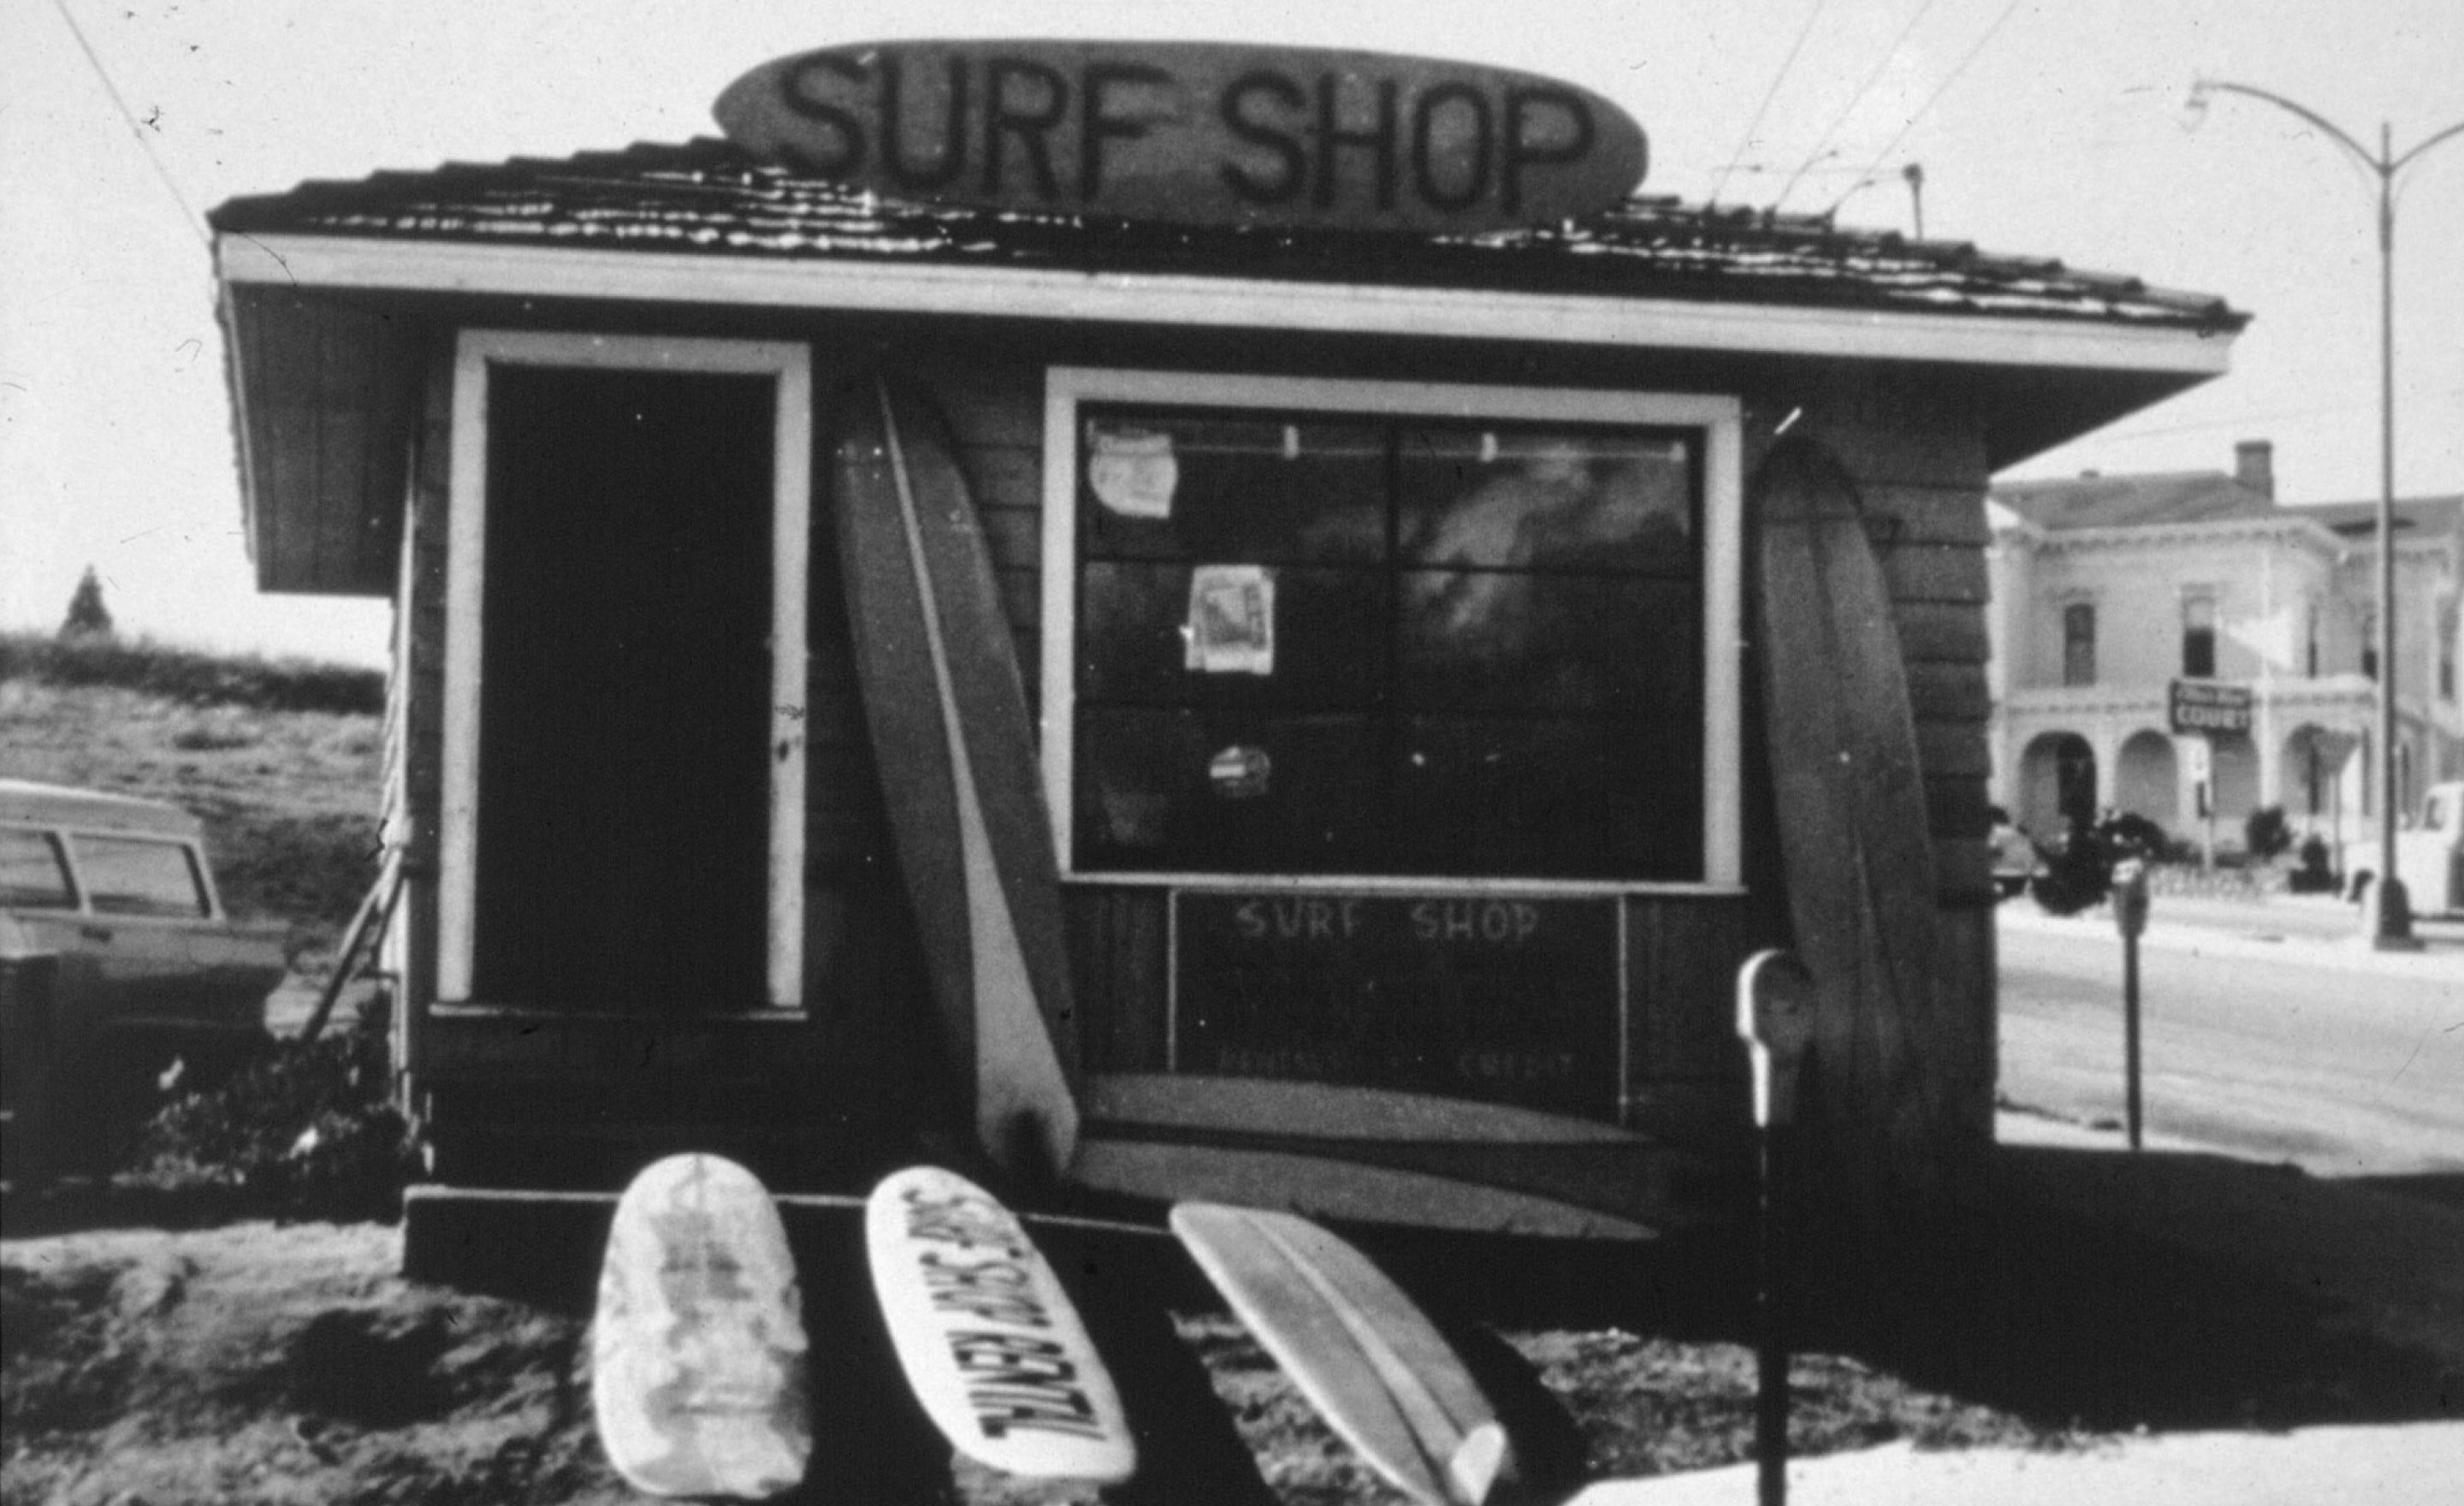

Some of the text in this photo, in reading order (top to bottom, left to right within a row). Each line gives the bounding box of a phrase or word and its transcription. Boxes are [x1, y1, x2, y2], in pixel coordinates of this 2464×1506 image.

[780, 51, 1598, 216] SURF SHOP
[1235, 899, 1540, 940] SURF SHOP
